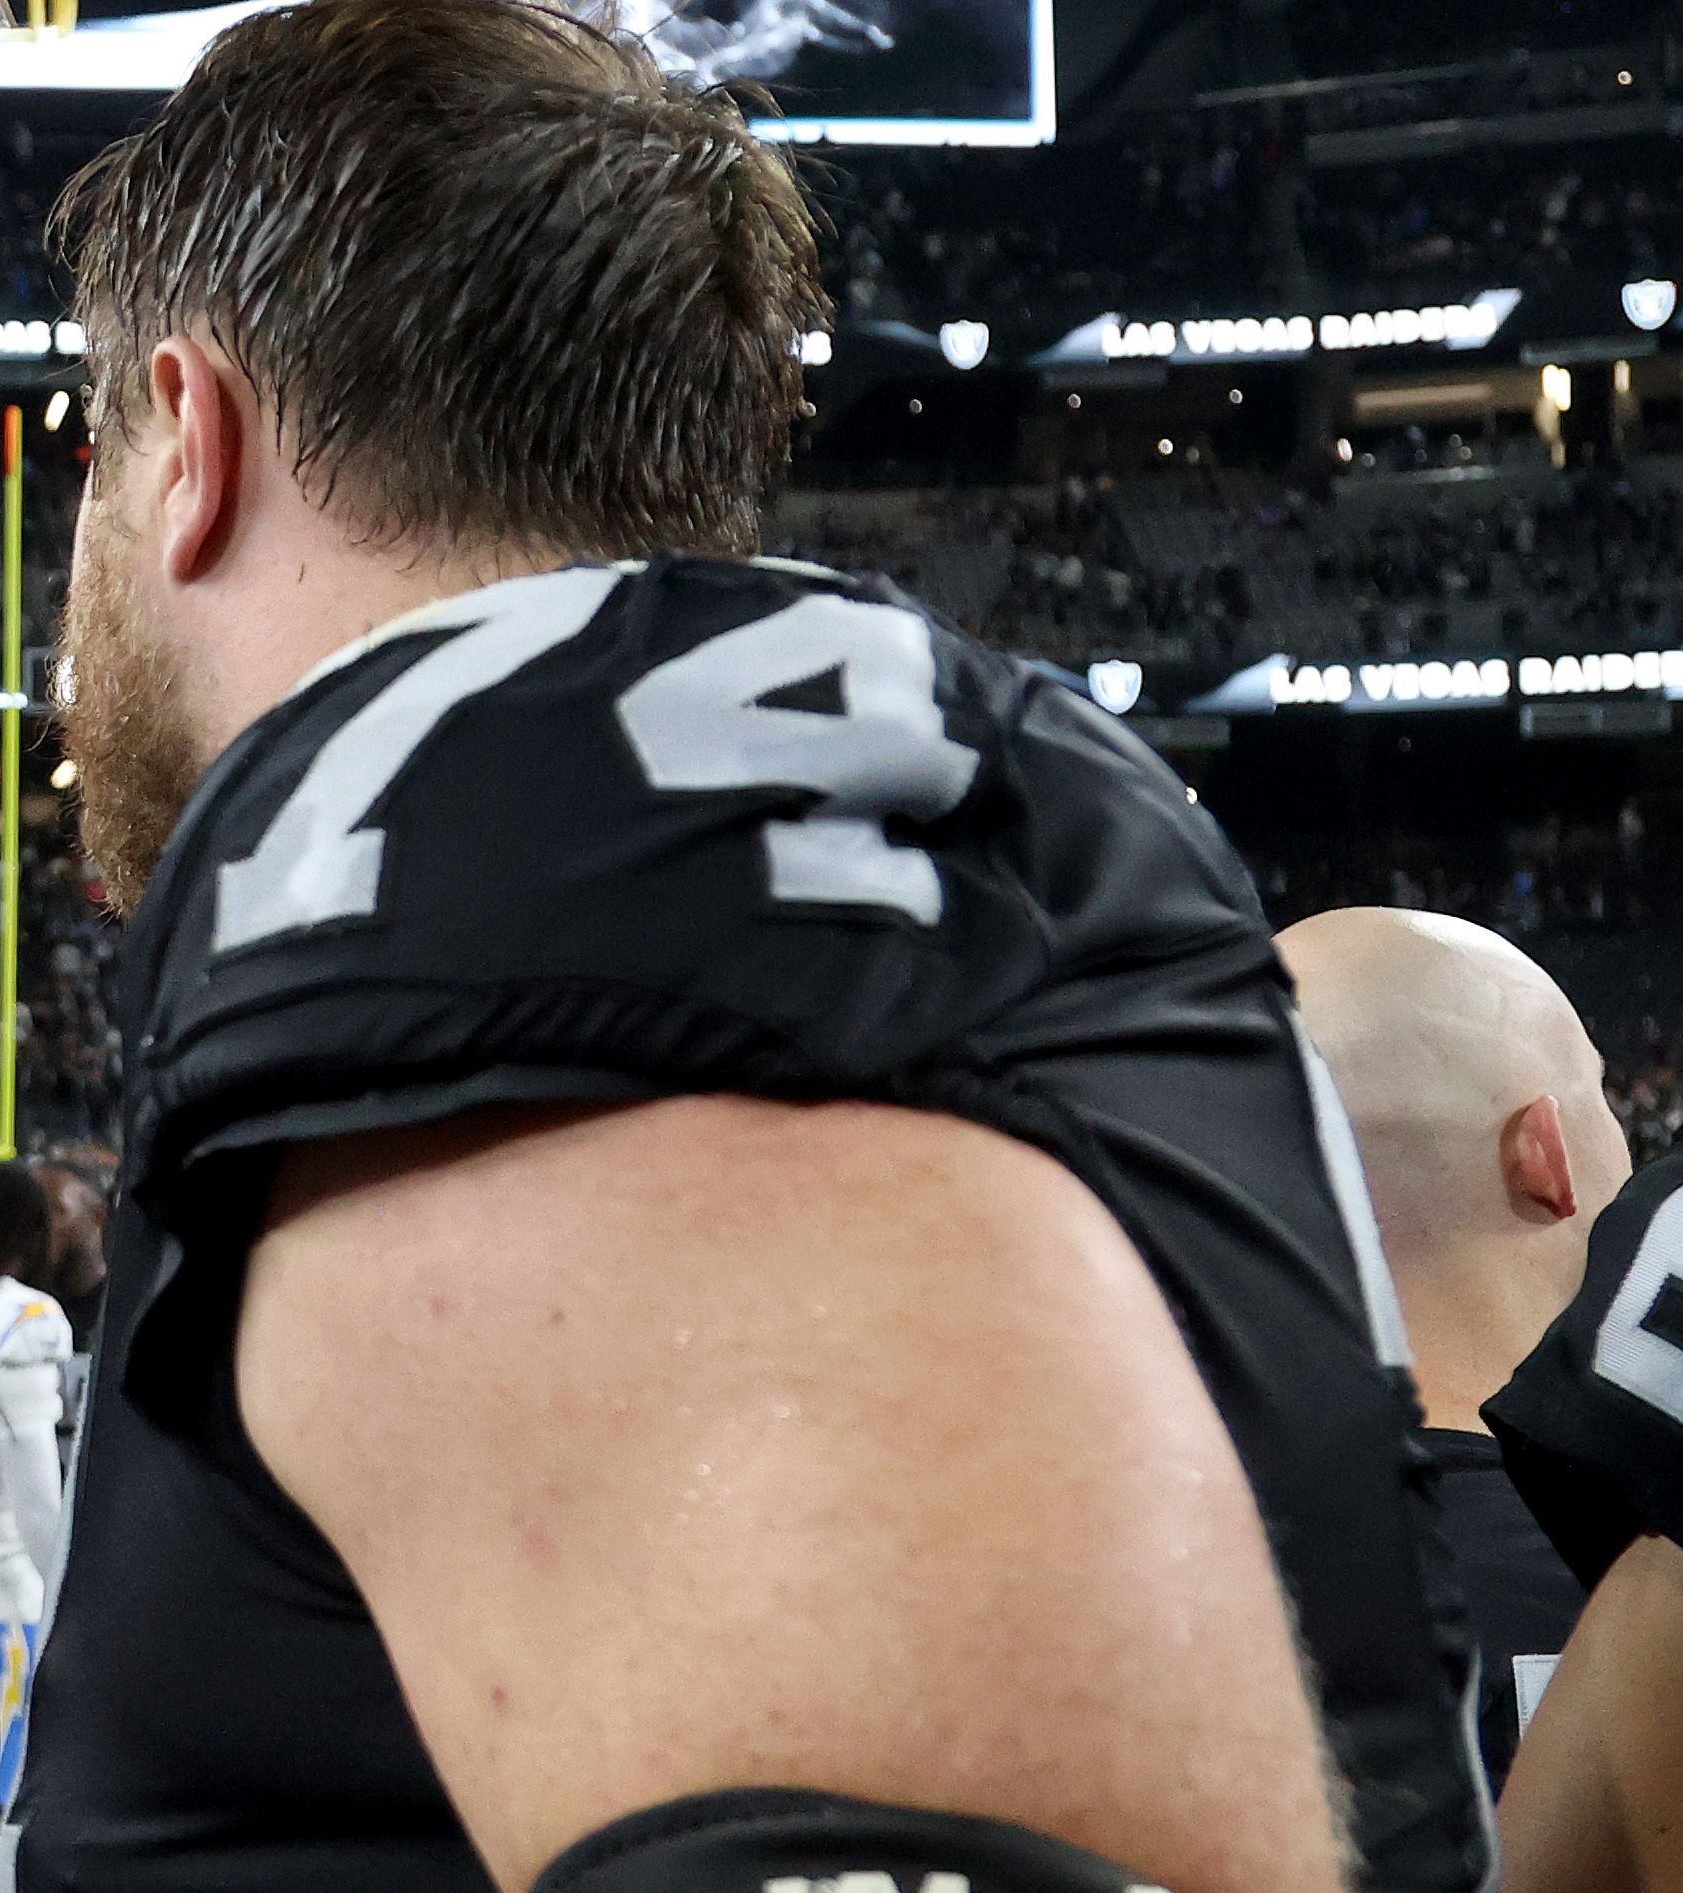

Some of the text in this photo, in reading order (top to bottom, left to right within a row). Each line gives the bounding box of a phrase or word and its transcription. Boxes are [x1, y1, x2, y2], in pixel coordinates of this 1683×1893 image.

[1101, 302, 1498, 357] LAS VEGAS RAIDERS
[1269, 664, 1352, 703] LAS
[1359, 658, 1512, 701] VEGAS
[212, 565, 981, 954] 74
